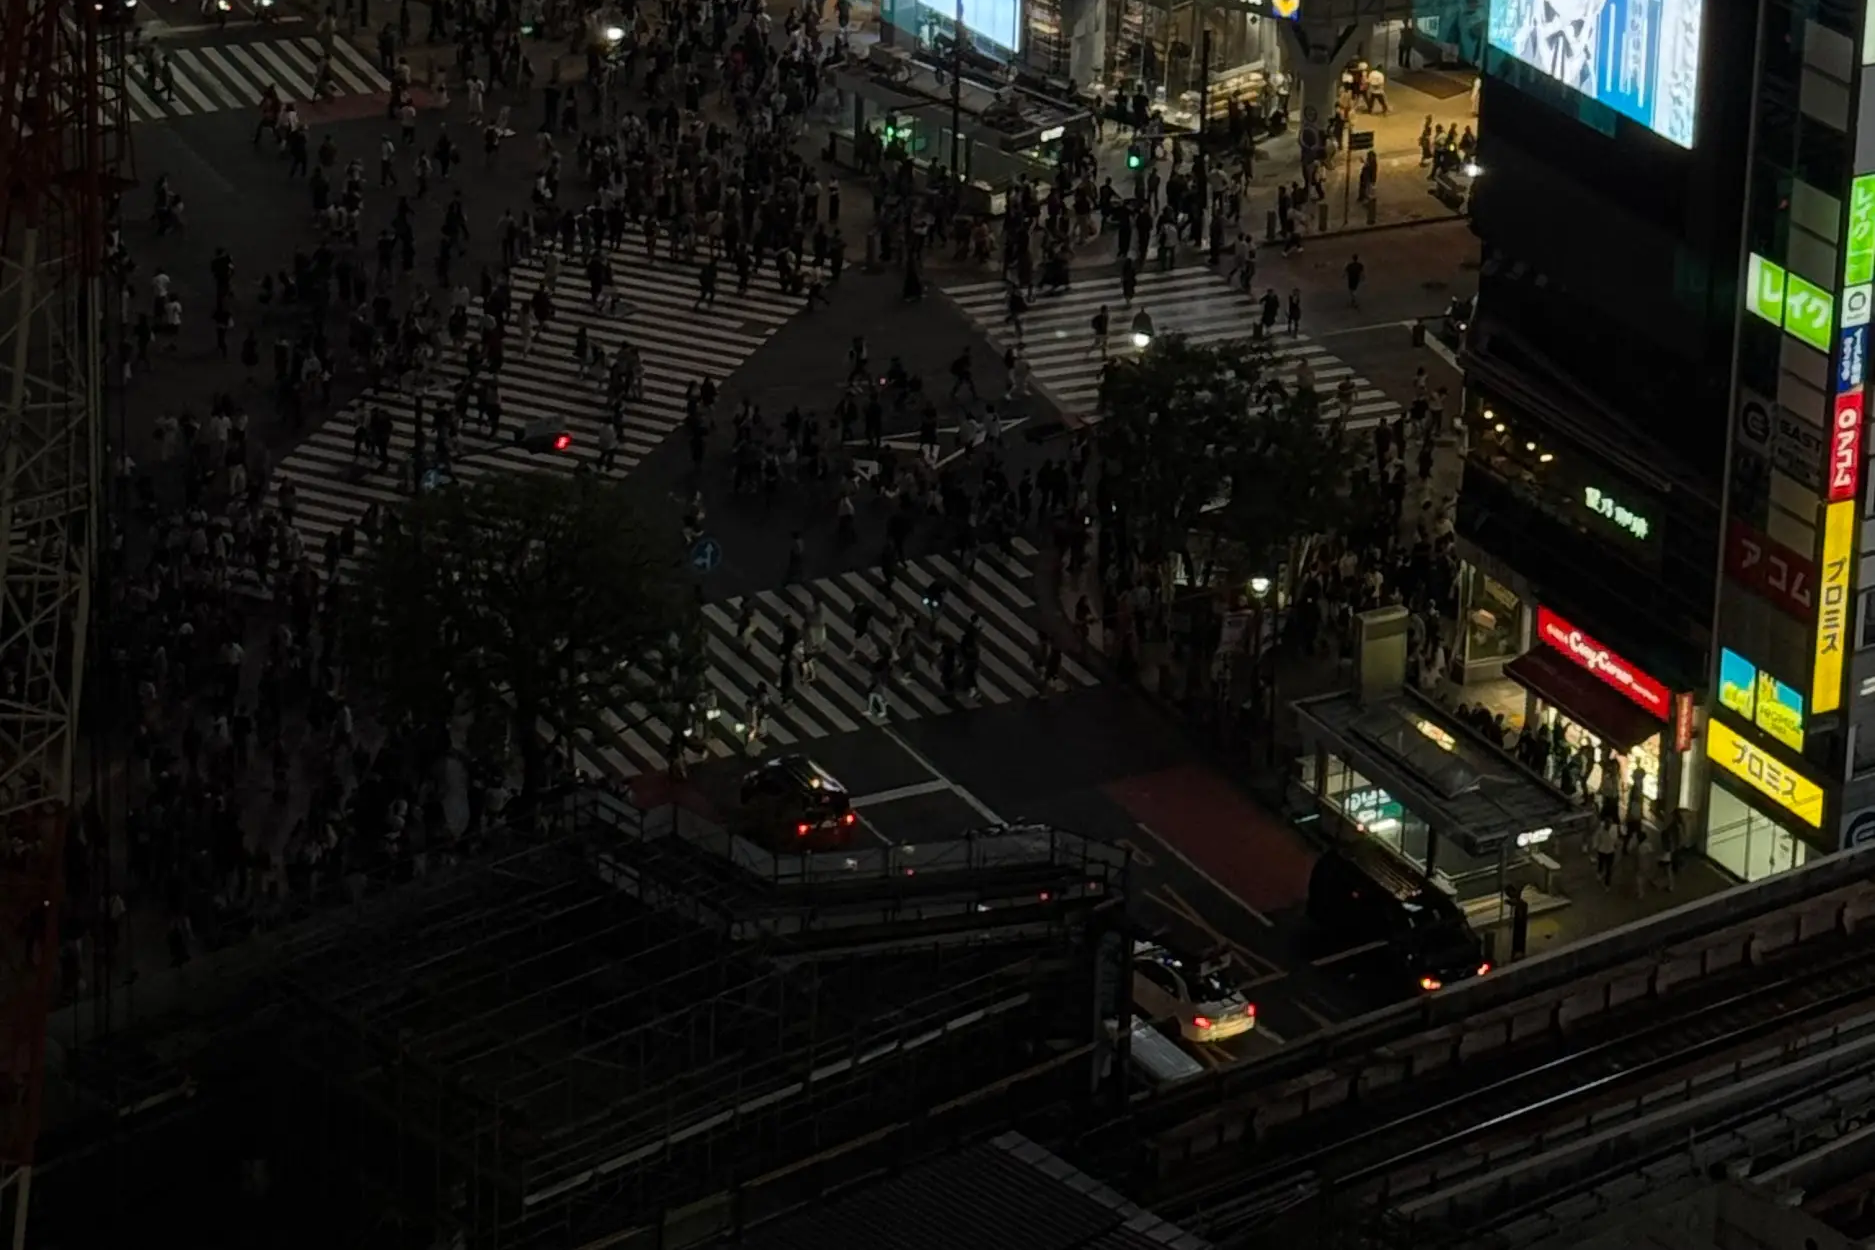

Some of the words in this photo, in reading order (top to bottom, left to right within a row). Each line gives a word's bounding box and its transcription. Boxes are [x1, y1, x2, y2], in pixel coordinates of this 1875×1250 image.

[1763, 267, 1828, 330] レイク
[1833, 431, 1857, 489] アコム
[1741, 536, 1812, 609] アコム
[1820, 557, 1848, 655] プロミス
[1731, 738, 1798, 806] プロミス
